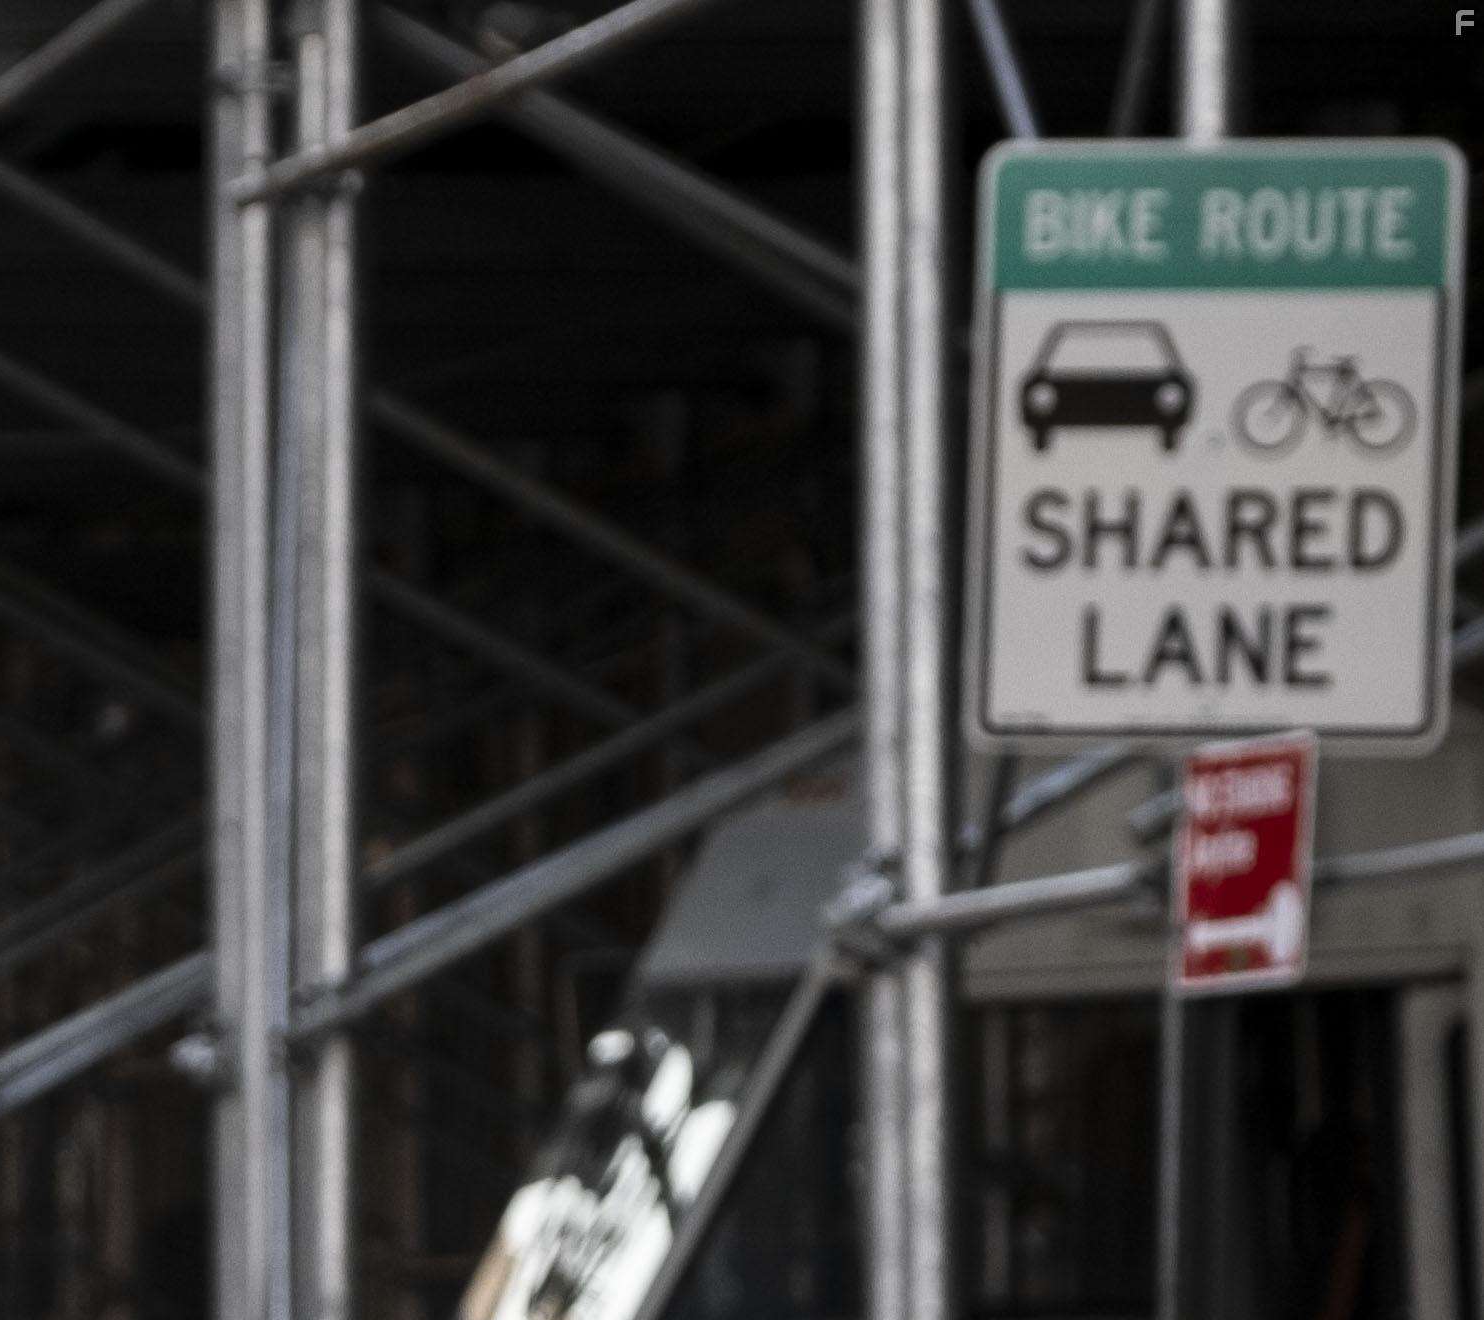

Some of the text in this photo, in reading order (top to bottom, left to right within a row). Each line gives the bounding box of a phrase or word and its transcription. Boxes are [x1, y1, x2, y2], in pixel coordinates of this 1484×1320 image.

[1023, 185, 1415, 260] BIKE ROUTE
[1022, 488, 1405, 574] SHARED
[1084, 604, 1332, 690] LANE
